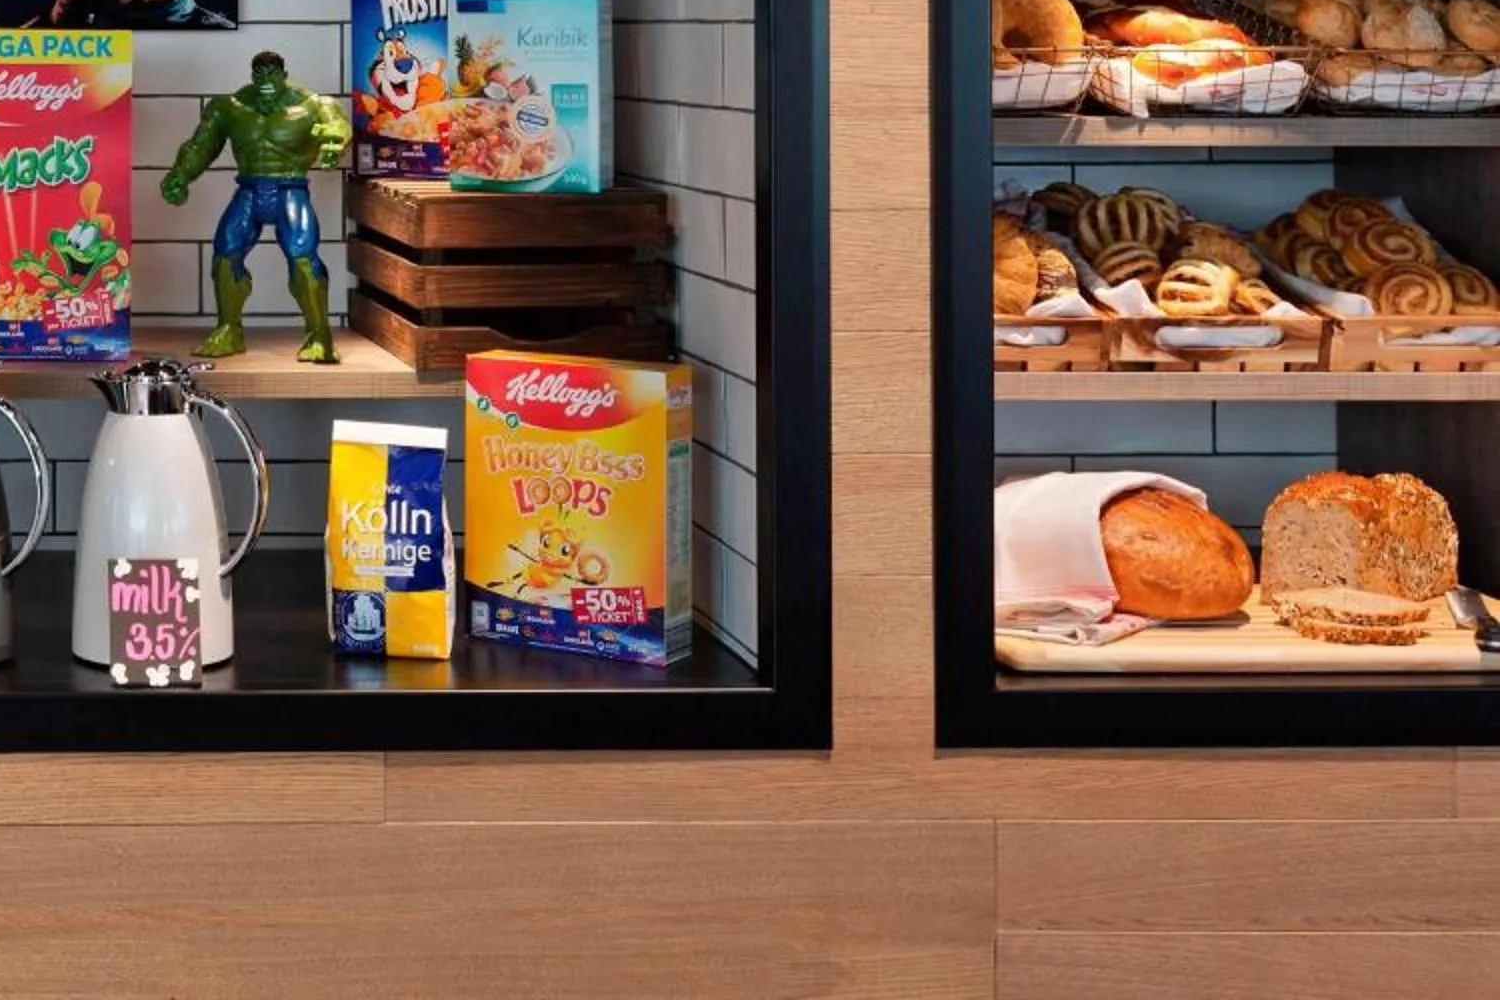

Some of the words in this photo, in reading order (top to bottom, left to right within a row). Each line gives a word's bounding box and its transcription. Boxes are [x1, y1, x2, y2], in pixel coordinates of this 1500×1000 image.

[43, 35, 113, 57] PACK
[517, 25, 589, 49] Karibik
[45, 298, 99, 319] -50%
[506, 367, 619, 417] Kellogg's
[483, 436, 574, 475] Honey
[340, 499, 432, 535] Kölln
[341, 539, 432, 567] Kernige
[112, 565, 187, 623] milk
[576, 589, 631, 611] -50%
[125, 623, 200, 661] 3.5%
